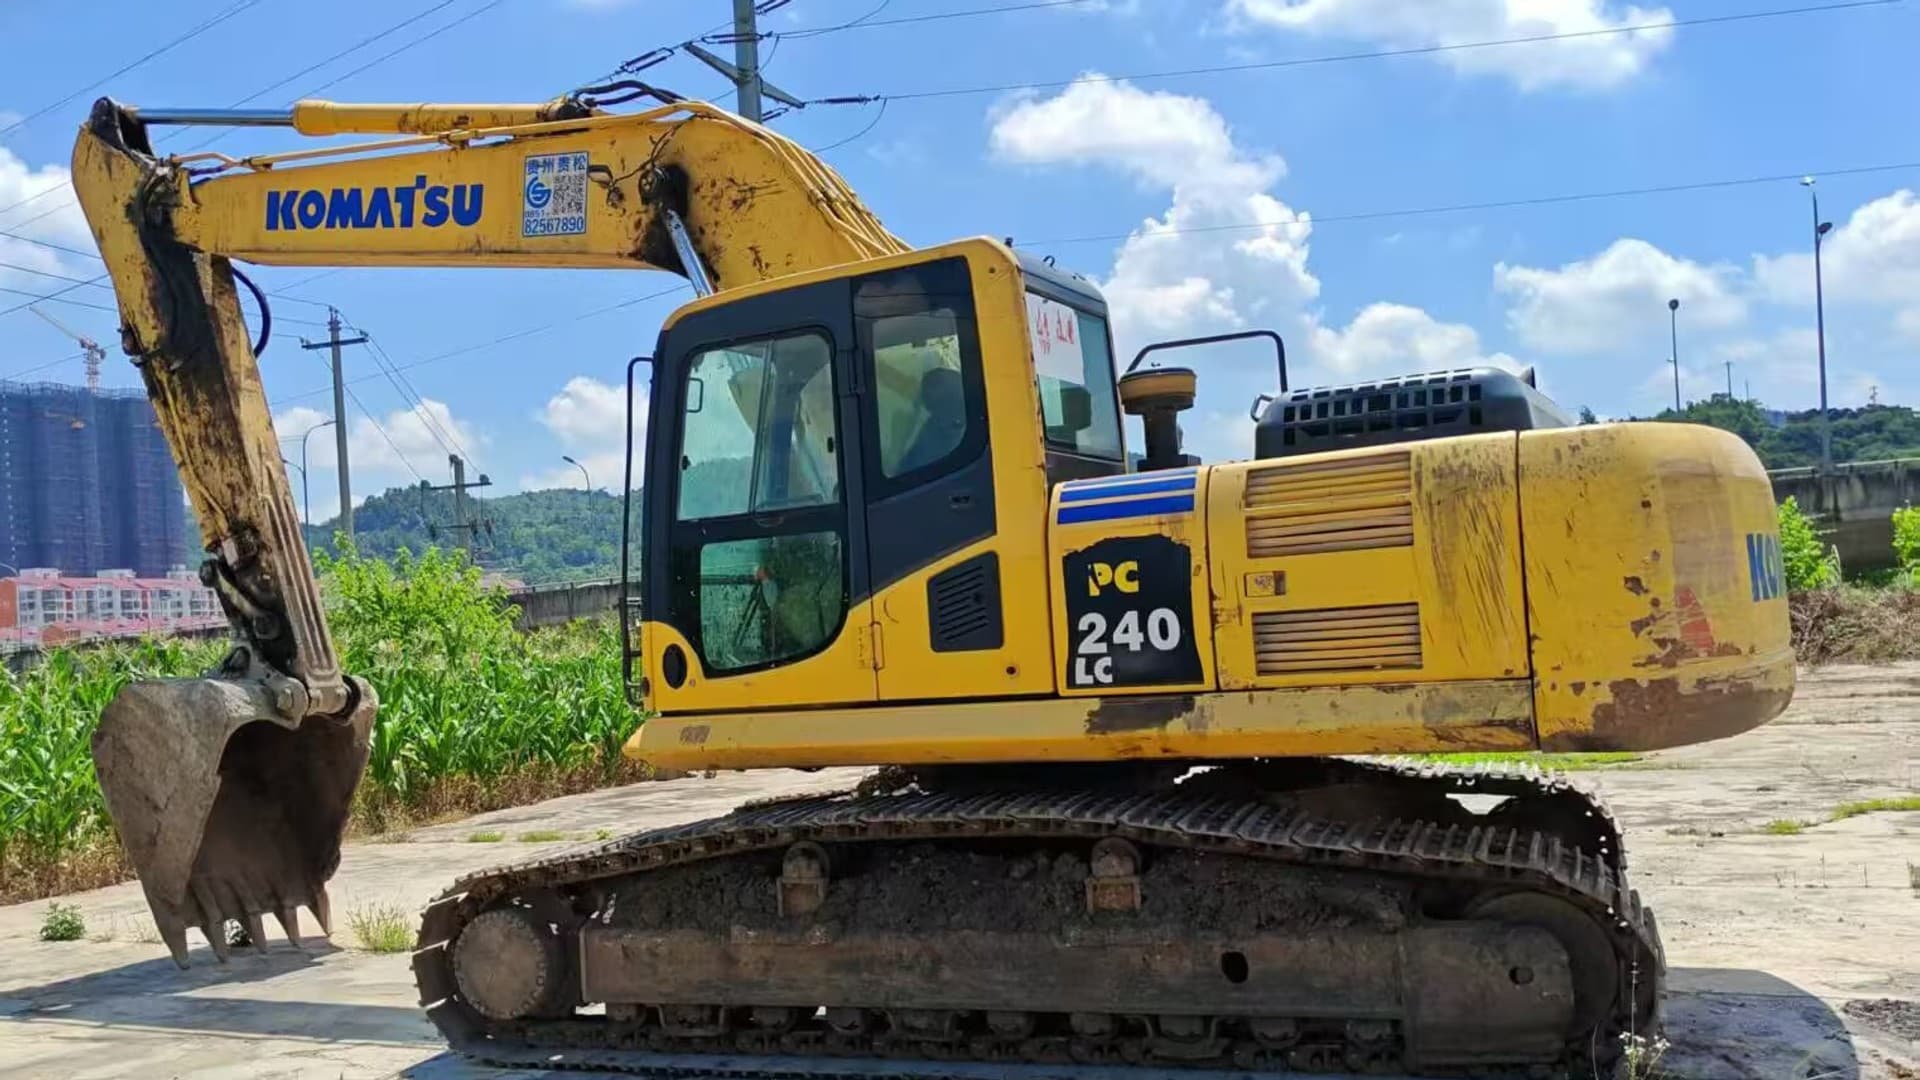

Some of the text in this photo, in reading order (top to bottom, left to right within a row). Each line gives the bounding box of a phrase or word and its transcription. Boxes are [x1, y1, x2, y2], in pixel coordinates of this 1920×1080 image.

[265, 175, 484, 230] KOMATSU
[525, 217, 584, 234] 82567890
[1088, 560, 1139, 597] PC
[1746, 533, 1785, 602] KO
[1077, 607, 1181, 654] 240
[1075, 656, 1113, 684] LC
